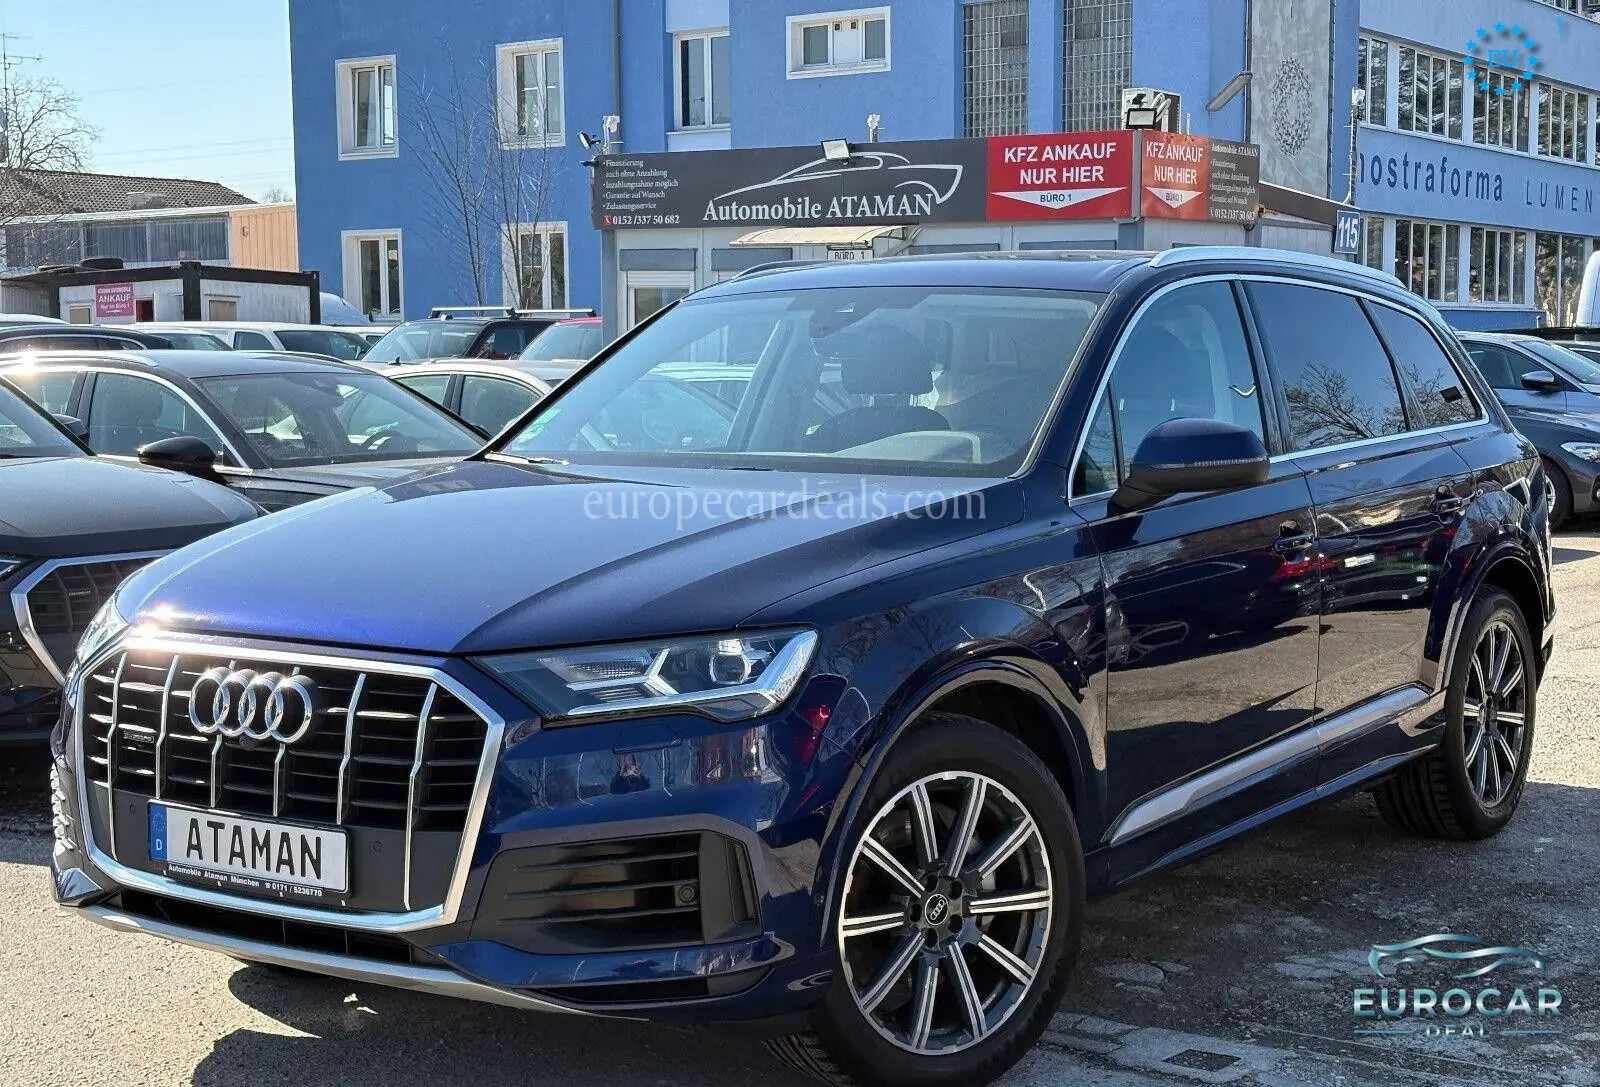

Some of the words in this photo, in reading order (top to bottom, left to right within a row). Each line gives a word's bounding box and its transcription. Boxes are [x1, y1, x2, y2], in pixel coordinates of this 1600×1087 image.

[1004, 146, 1038, 163] KFZ
[1041, 142, 1117, 161] ANKAUF
[1146, 140, 1165, 159] KFZ
[1166, 144, 1204, 163] ANKAUF
[605, 160, 644, 168] Finanzierung
[605, 170, 620, 178] auch
[620, 169, 635, 177] ohne
[636, 168, 668, 179] Anzahlung
[1020, 168, 1057, 185] NUR
[1062, 165, 1105, 183] HIER
[1154, 164, 1174, 183] NUR
[1176, 167, 1197, 185] HIER
[654, 178, 679, 189] möglich
[605, 191, 631, 199] Garantie
[631, 191, 641, 199] auf
[641, 190, 666, 198] Wunsch
[1040, 193, 1065, 203] BÜRO
[1067, 193, 1072, 202] 1
[1526, 180, 1593, 214] LUMEN
[605, 202, 657, 212] Zulassungsservice
[702, 196, 821, 221] Automobile
[825, 193, 934, 219] ATAMAN
[612, 215, 633, 225] 0152
[653, 215, 663, 225] 50
[664, 214, 680, 224] 682
[1338, 216, 1359, 249] 115
[98, 294, 131, 303] ANKAUF
[155, 838, 163, 851] D
[186, 817, 322, 880] ATAMAN
[168, 863, 202, 877] Automobile
[203, 871, 228, 882] Ataman
[230, 875, 260, 888] München
[272, 883, 288, 892] 0171
